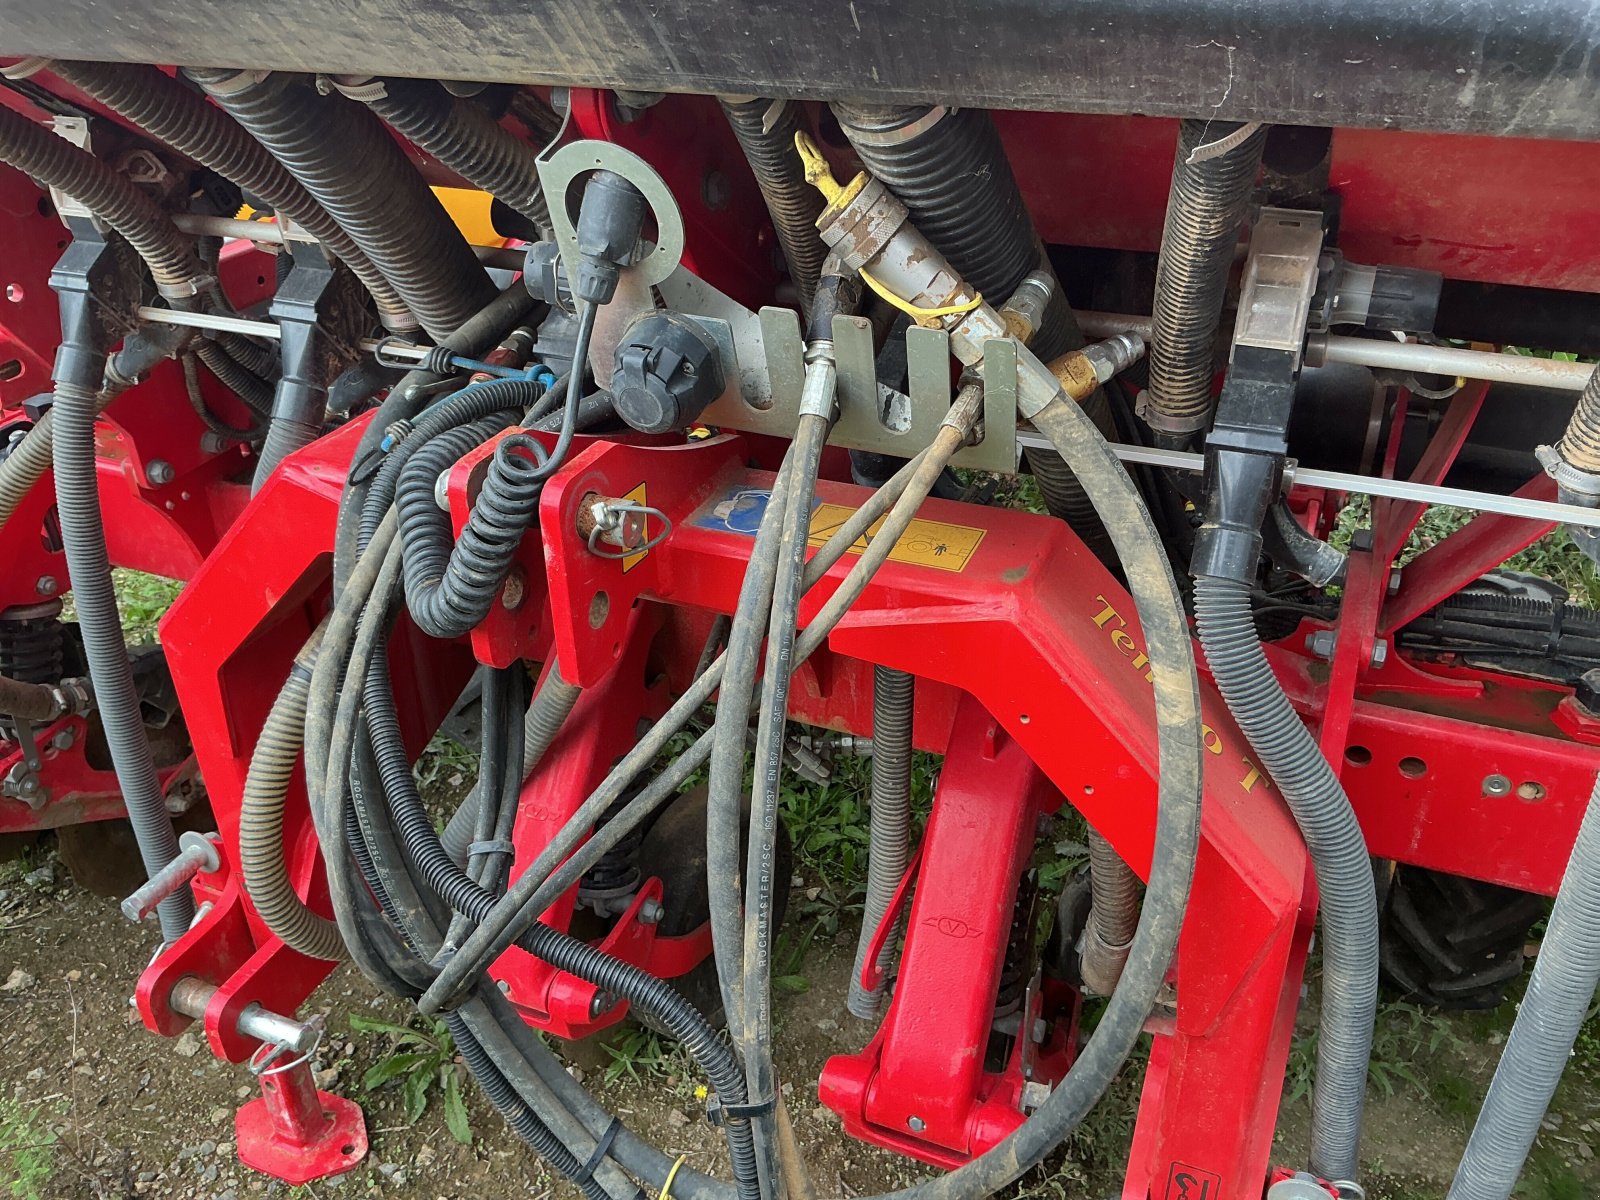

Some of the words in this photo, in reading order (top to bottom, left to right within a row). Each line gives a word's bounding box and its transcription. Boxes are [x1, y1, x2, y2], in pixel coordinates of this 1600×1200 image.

[767, 770, 776, 781] EN
[1238, 755, 1271, 794] T
[766, 790, 775, 812] 11237
[353, 780, 382, 861] ROCKMASTER/2SC
[765, 815, 774, 831] ISO
[758, 843, 772, 967] ROCKMASTER/2SC
